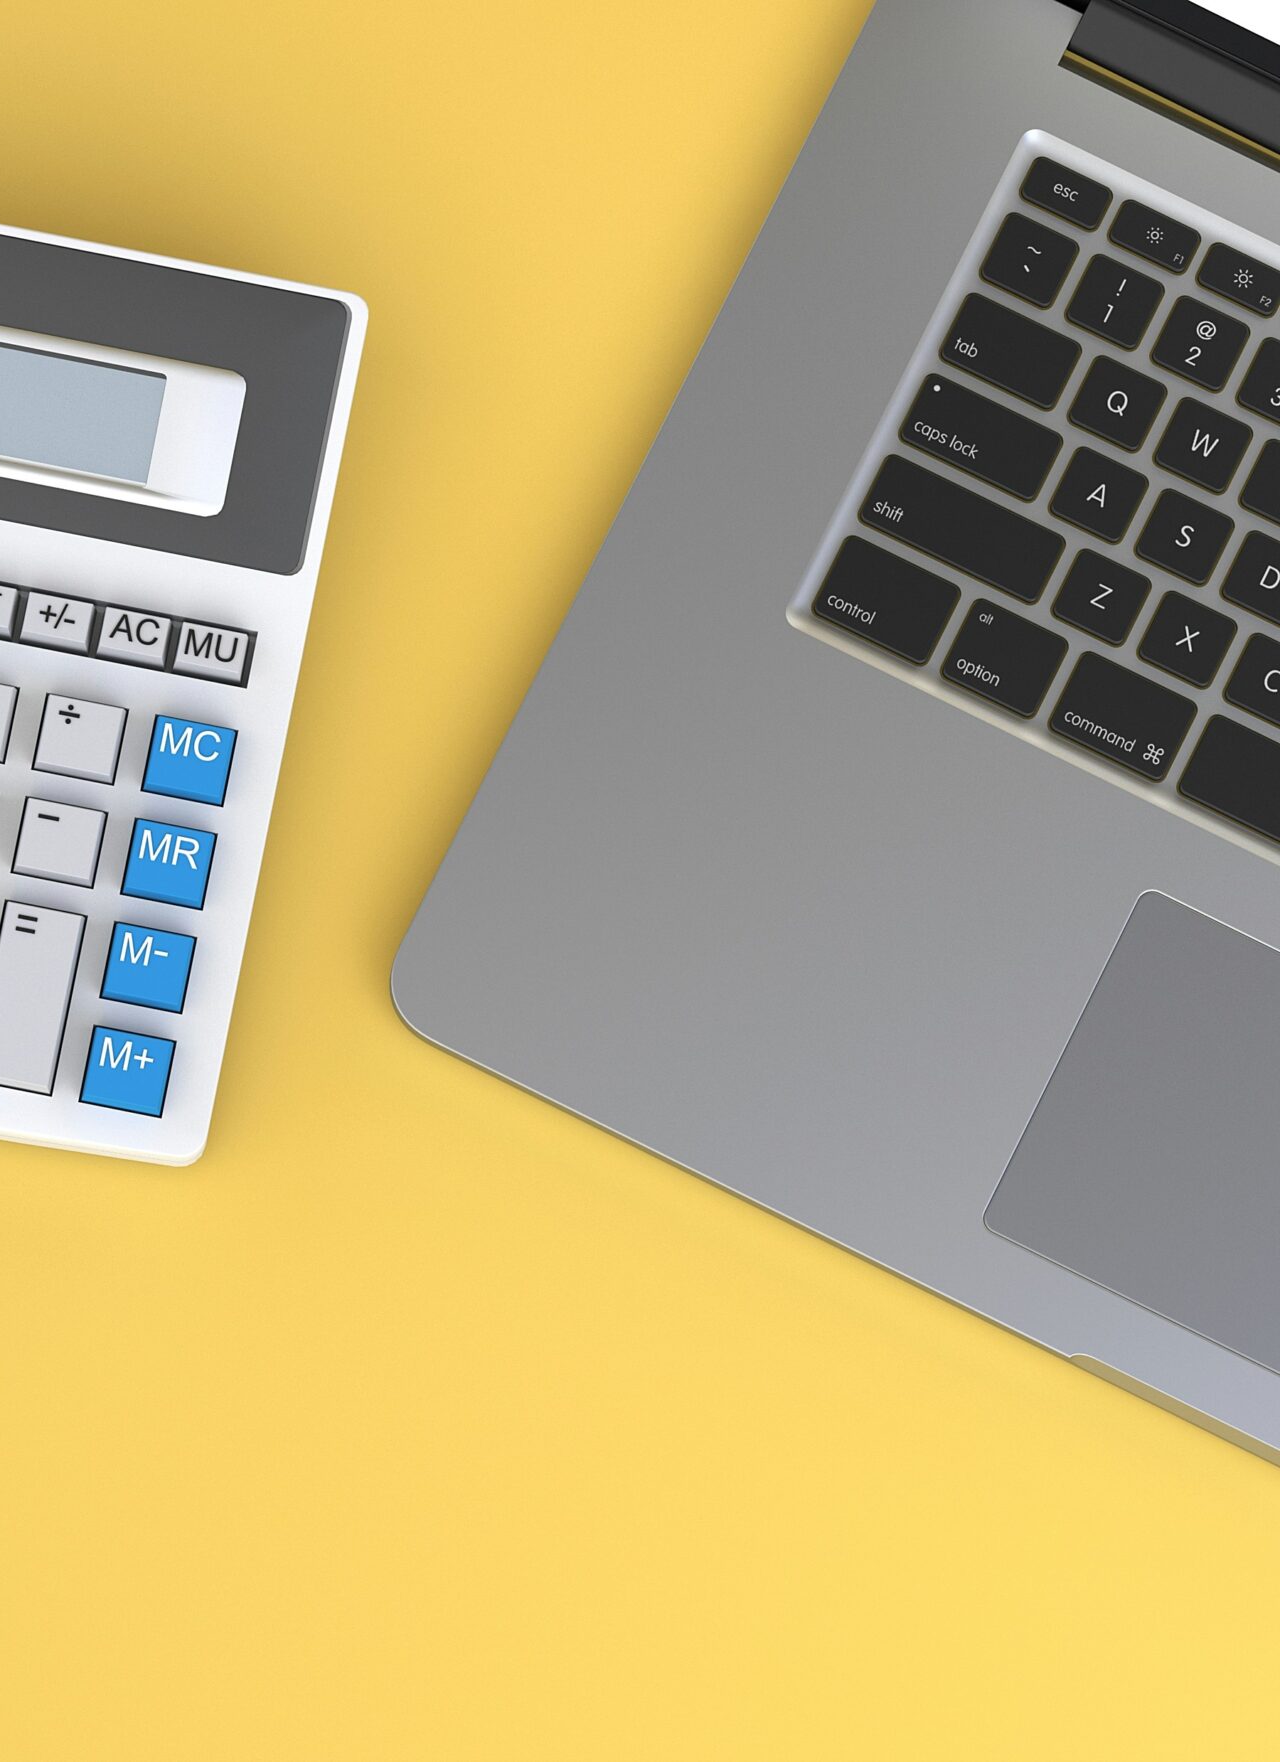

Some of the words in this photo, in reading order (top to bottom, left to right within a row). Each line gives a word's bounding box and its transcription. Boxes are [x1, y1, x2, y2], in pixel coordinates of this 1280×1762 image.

[1053, 183, 1079, 202] esc
[1173, 253, 1185, 265] F1
[1116, 279, 1127, 297] !
[1259, 295, 1272, 307] F2
[1103, 304, 1114, 323] 1
[1196, 320, 1217, 340] @
[954, 337, 978, 358] tab
[1184, 346, 1202, 366] 2
[1107, 390, 1128, 417] Q
[914, 421, 948, 444] caps
[949, 434, 978, 459] lock
[1191, 429, 1219, 457] W
[1086, 483, 1106, 508] A
[873, 501, 904, 523] shift
[1175, 525, 1195, 547] S
[1259, 565, 1280, 589] D
[1090, 583, 1113, 610] Z
[827, 595, 876, 625] control
[979, 613, 994, 625] alt
[108, 613, 161, 647] AC
[1175, 625, 1200, 653] X
[183, 629, 239, 663] MU
[956, 658, 1000, 687] option
[159, 722, 222, 763] MC
[1063, 710, 1136, 753] command
[139, 829, 200, 870] MR
[15, 913, 38, 935] =
[119, 932, 170, 966] M-
[98, 1035, 155, 1072] M+
